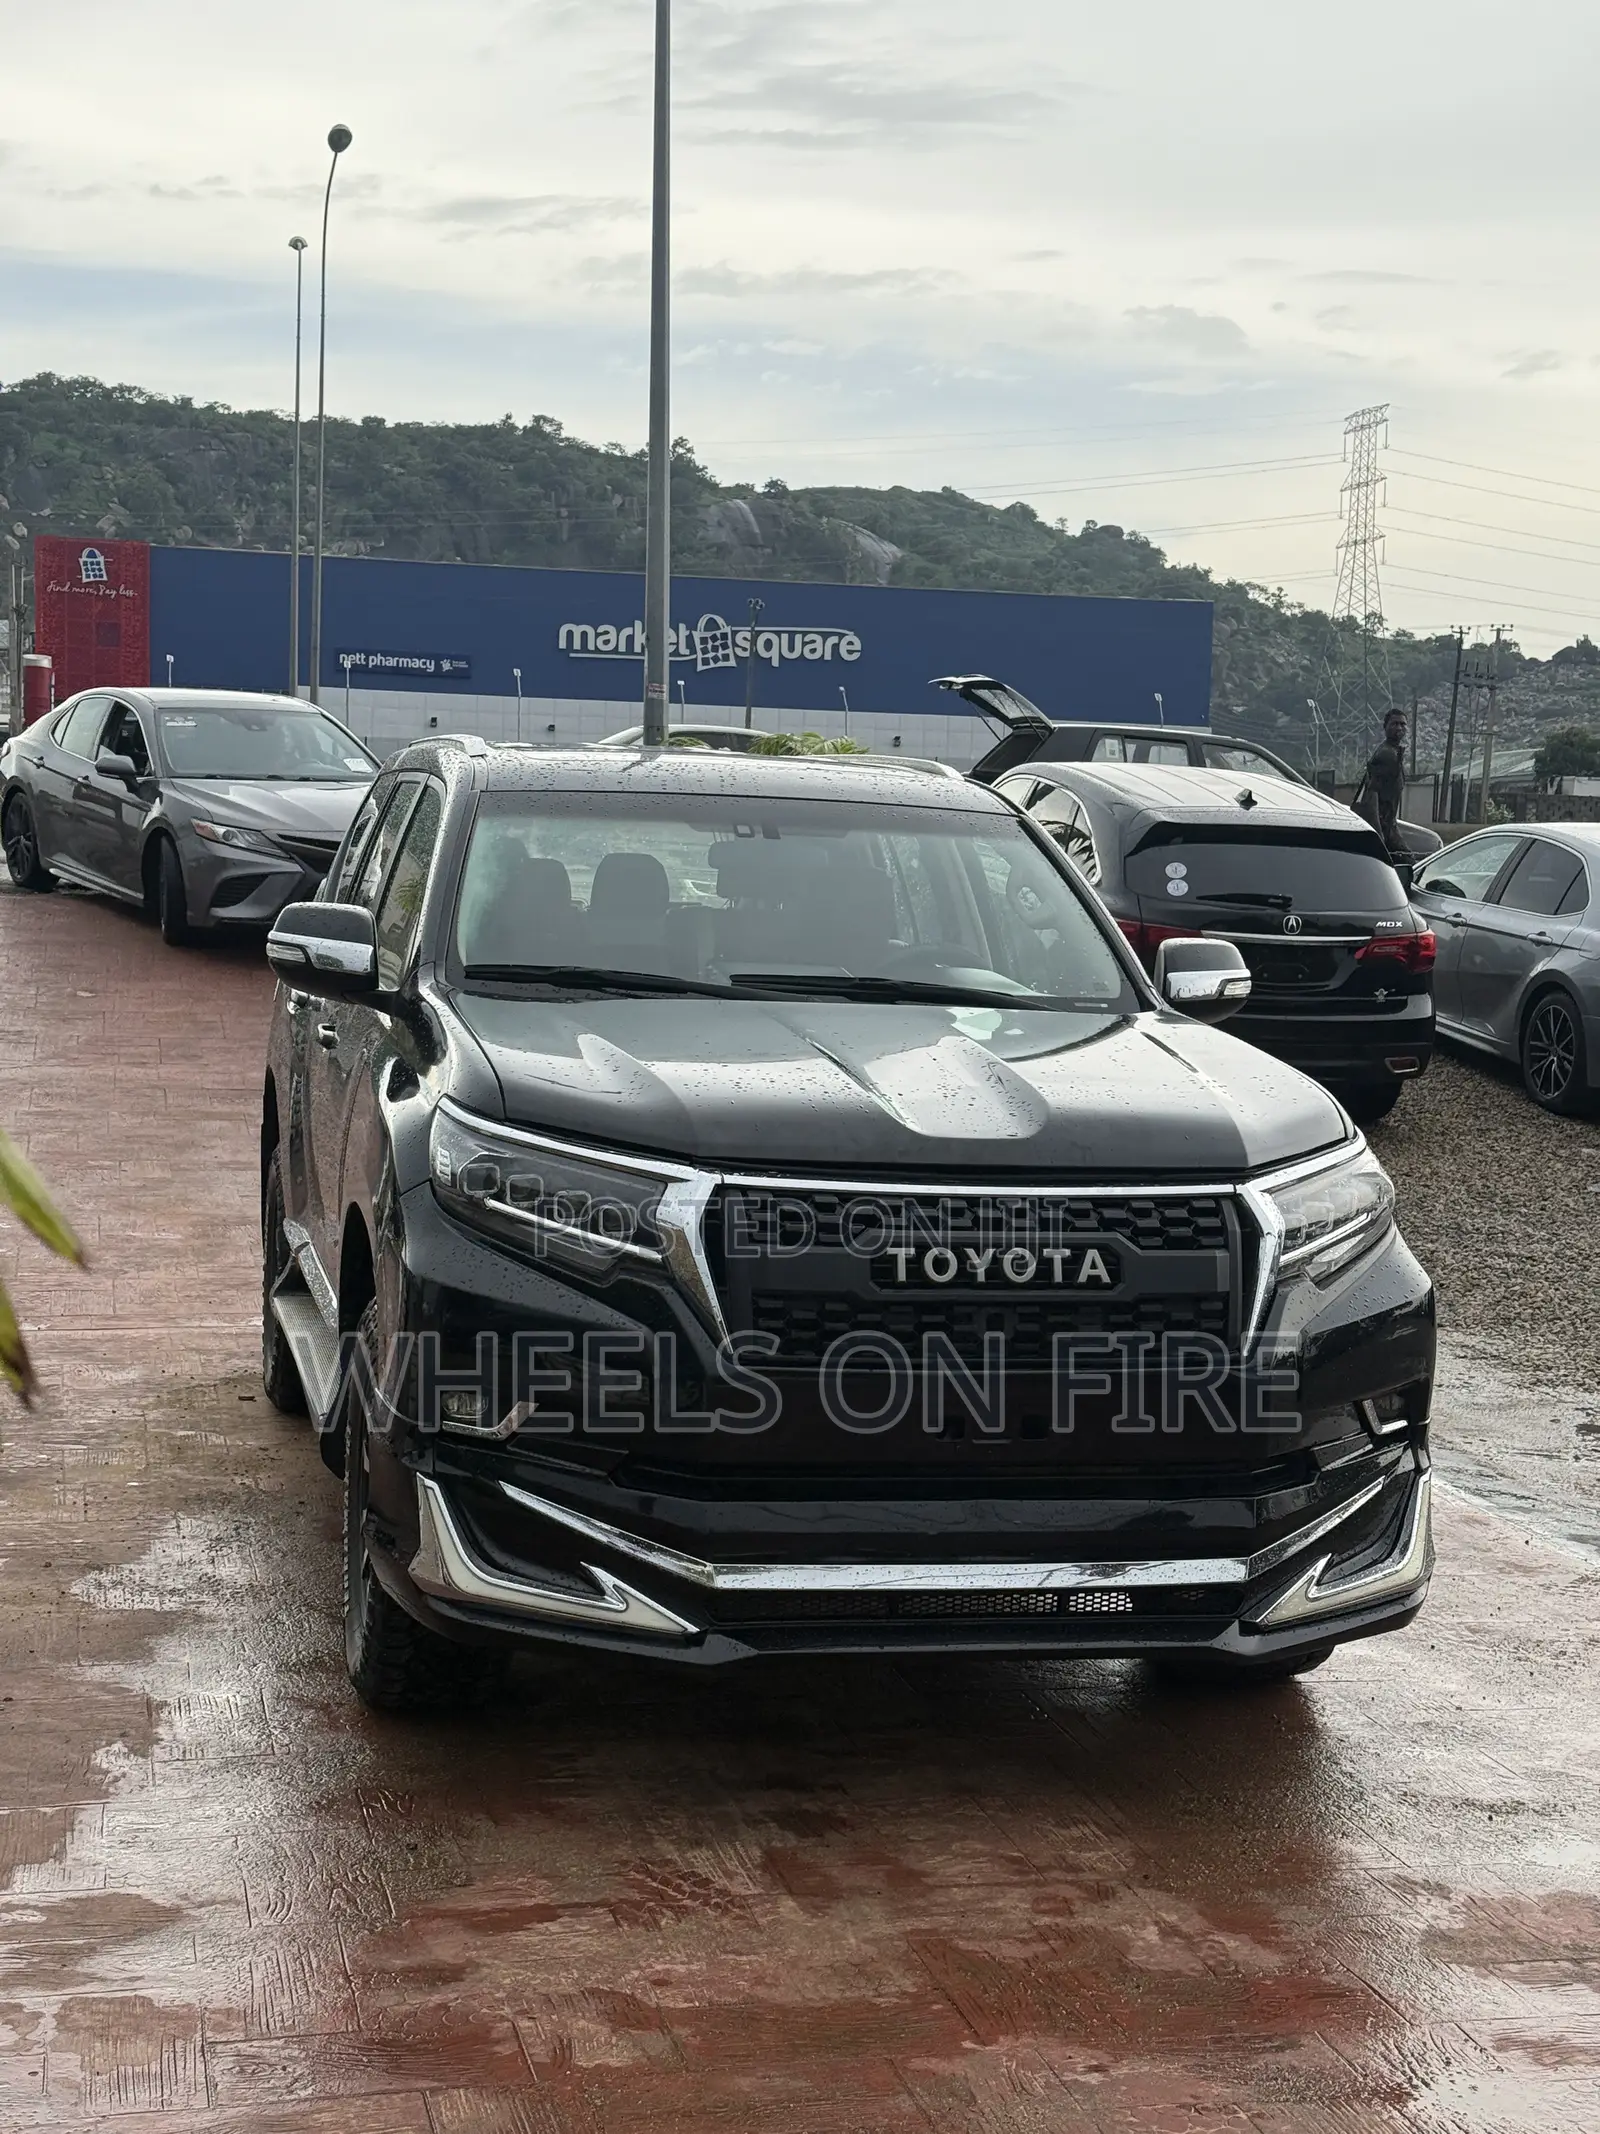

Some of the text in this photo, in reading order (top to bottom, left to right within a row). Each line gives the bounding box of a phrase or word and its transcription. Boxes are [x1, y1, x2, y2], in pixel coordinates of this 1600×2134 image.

[339, 652, 367, 665] nett
[368, 653, 435, 672] pharmacy
[734, 631, 862, 668] square
[886, 1246, 1112, 1285] TOYOTA
